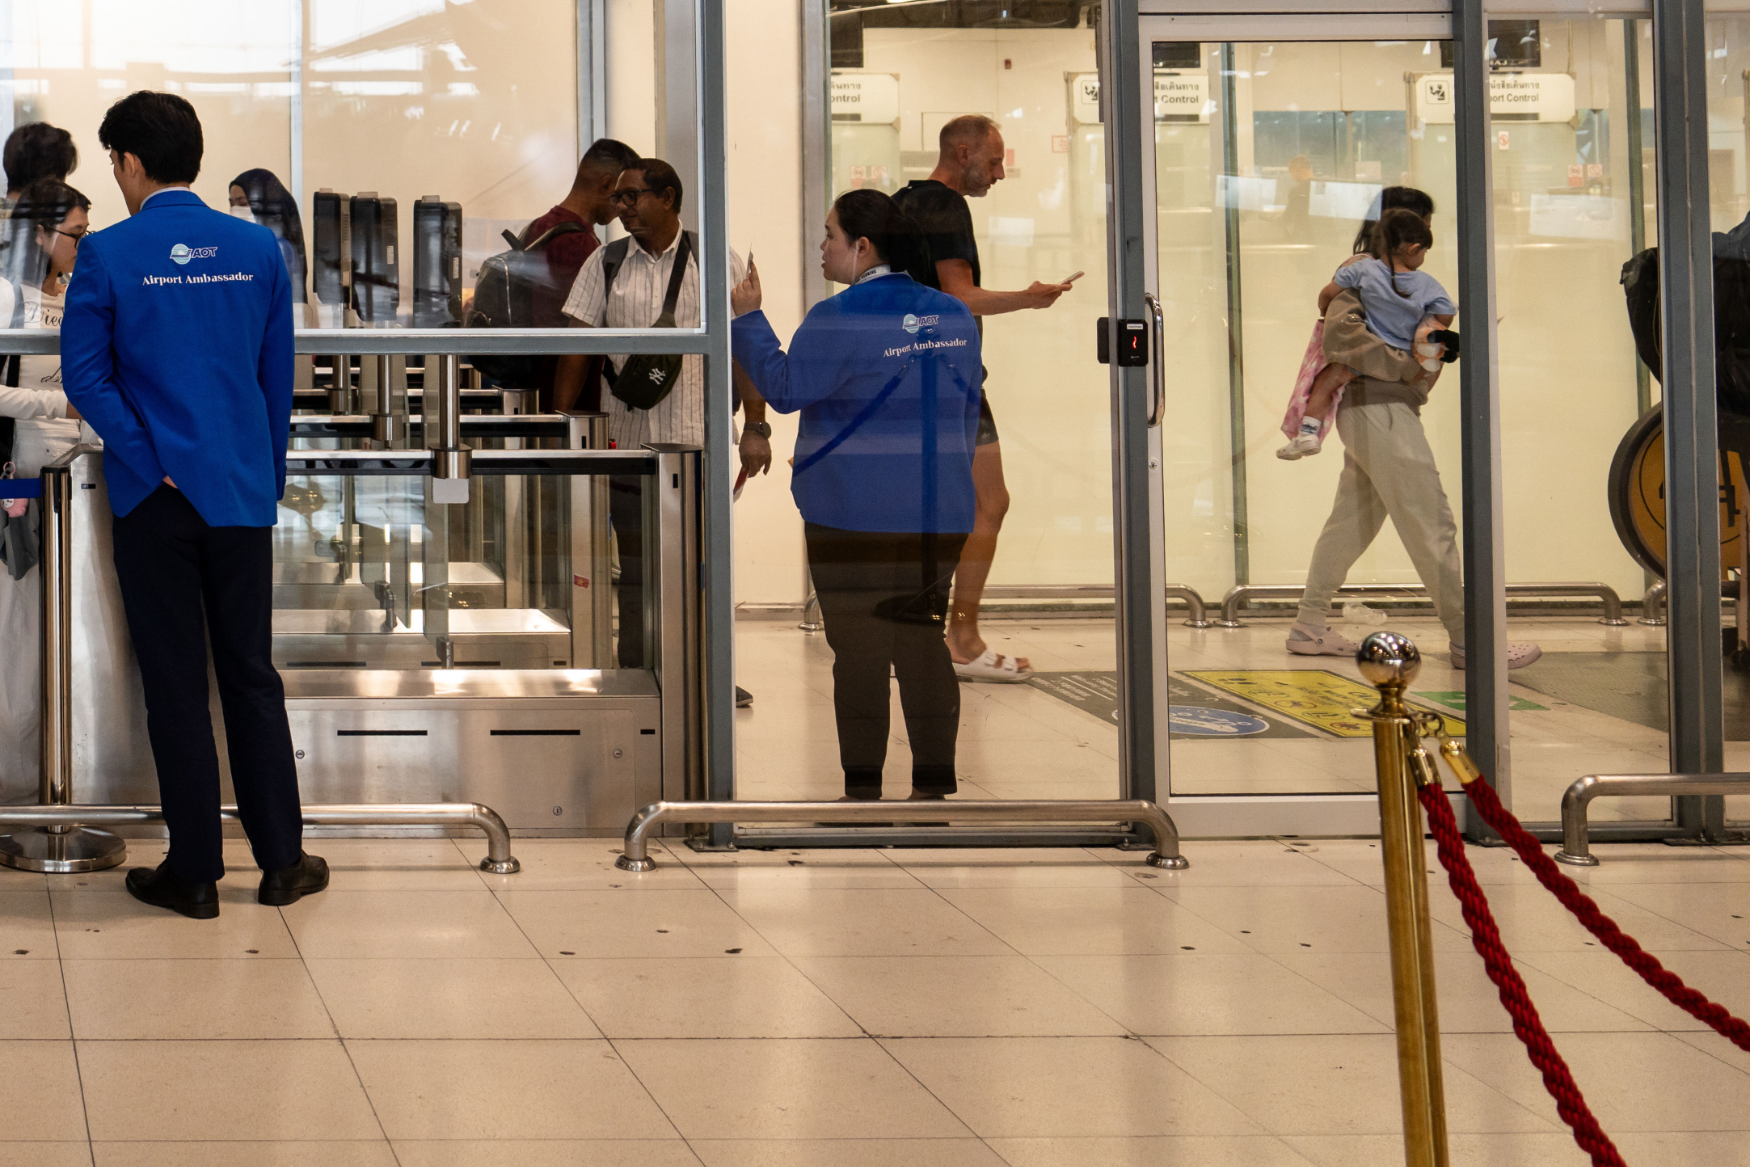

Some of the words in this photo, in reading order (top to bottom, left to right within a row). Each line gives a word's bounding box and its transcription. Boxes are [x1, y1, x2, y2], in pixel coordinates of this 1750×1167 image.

[1161, 95, 1199, 103] Control
[1506, 93, 1539, 102] Control
[142, 274, 183, 286] Airport
[185, 271, 254, 284] Ambassador
[883, 344, 912, 357] Airport
[912, 338, 968, 351] Ambassador
